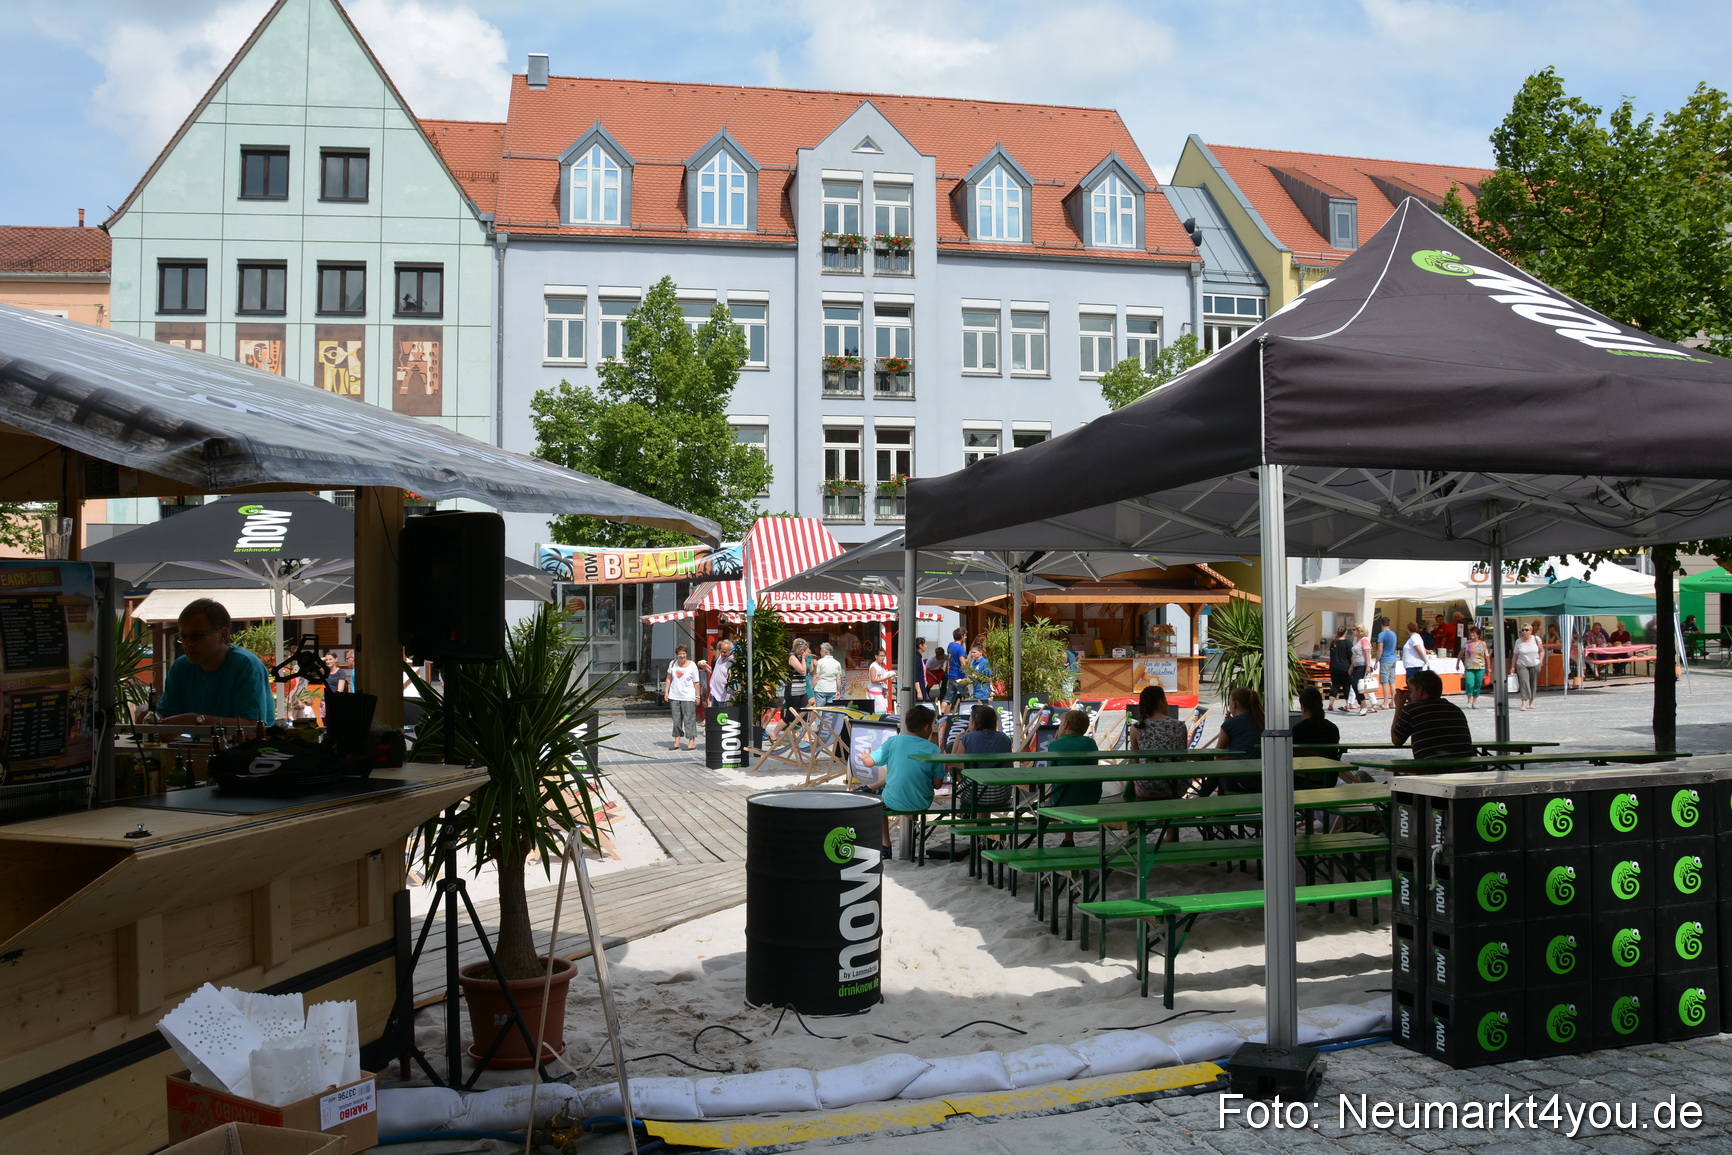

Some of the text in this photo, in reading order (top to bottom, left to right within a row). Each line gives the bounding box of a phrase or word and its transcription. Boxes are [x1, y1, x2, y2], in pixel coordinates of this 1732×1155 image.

[1464, 265, 1690, 357] now
[235, 509, 292, 547] now
[0, 571, 55, 586] EACH-TIME
[584, 550, 695, 582] now BEACH
[774, 591, 834, 602] BACKSTUBE
[722, 718, 742, 764] now
[1400, 809, 1409, 838] now
[1401, 876, 1410, 906] now
[1436, 884, 1446, 914] now
[839, 844, 881, 982] now
[1401, 943, 1410, 973] now
[1436, 952, 1446, 984] now
[838, 976, 879, 997] drinknow.de
[1401, 1009, 1411, 1040] now
[1436, 1021, 1446, 1053] now
[339, 1102, 368, 1120] HARIBO
